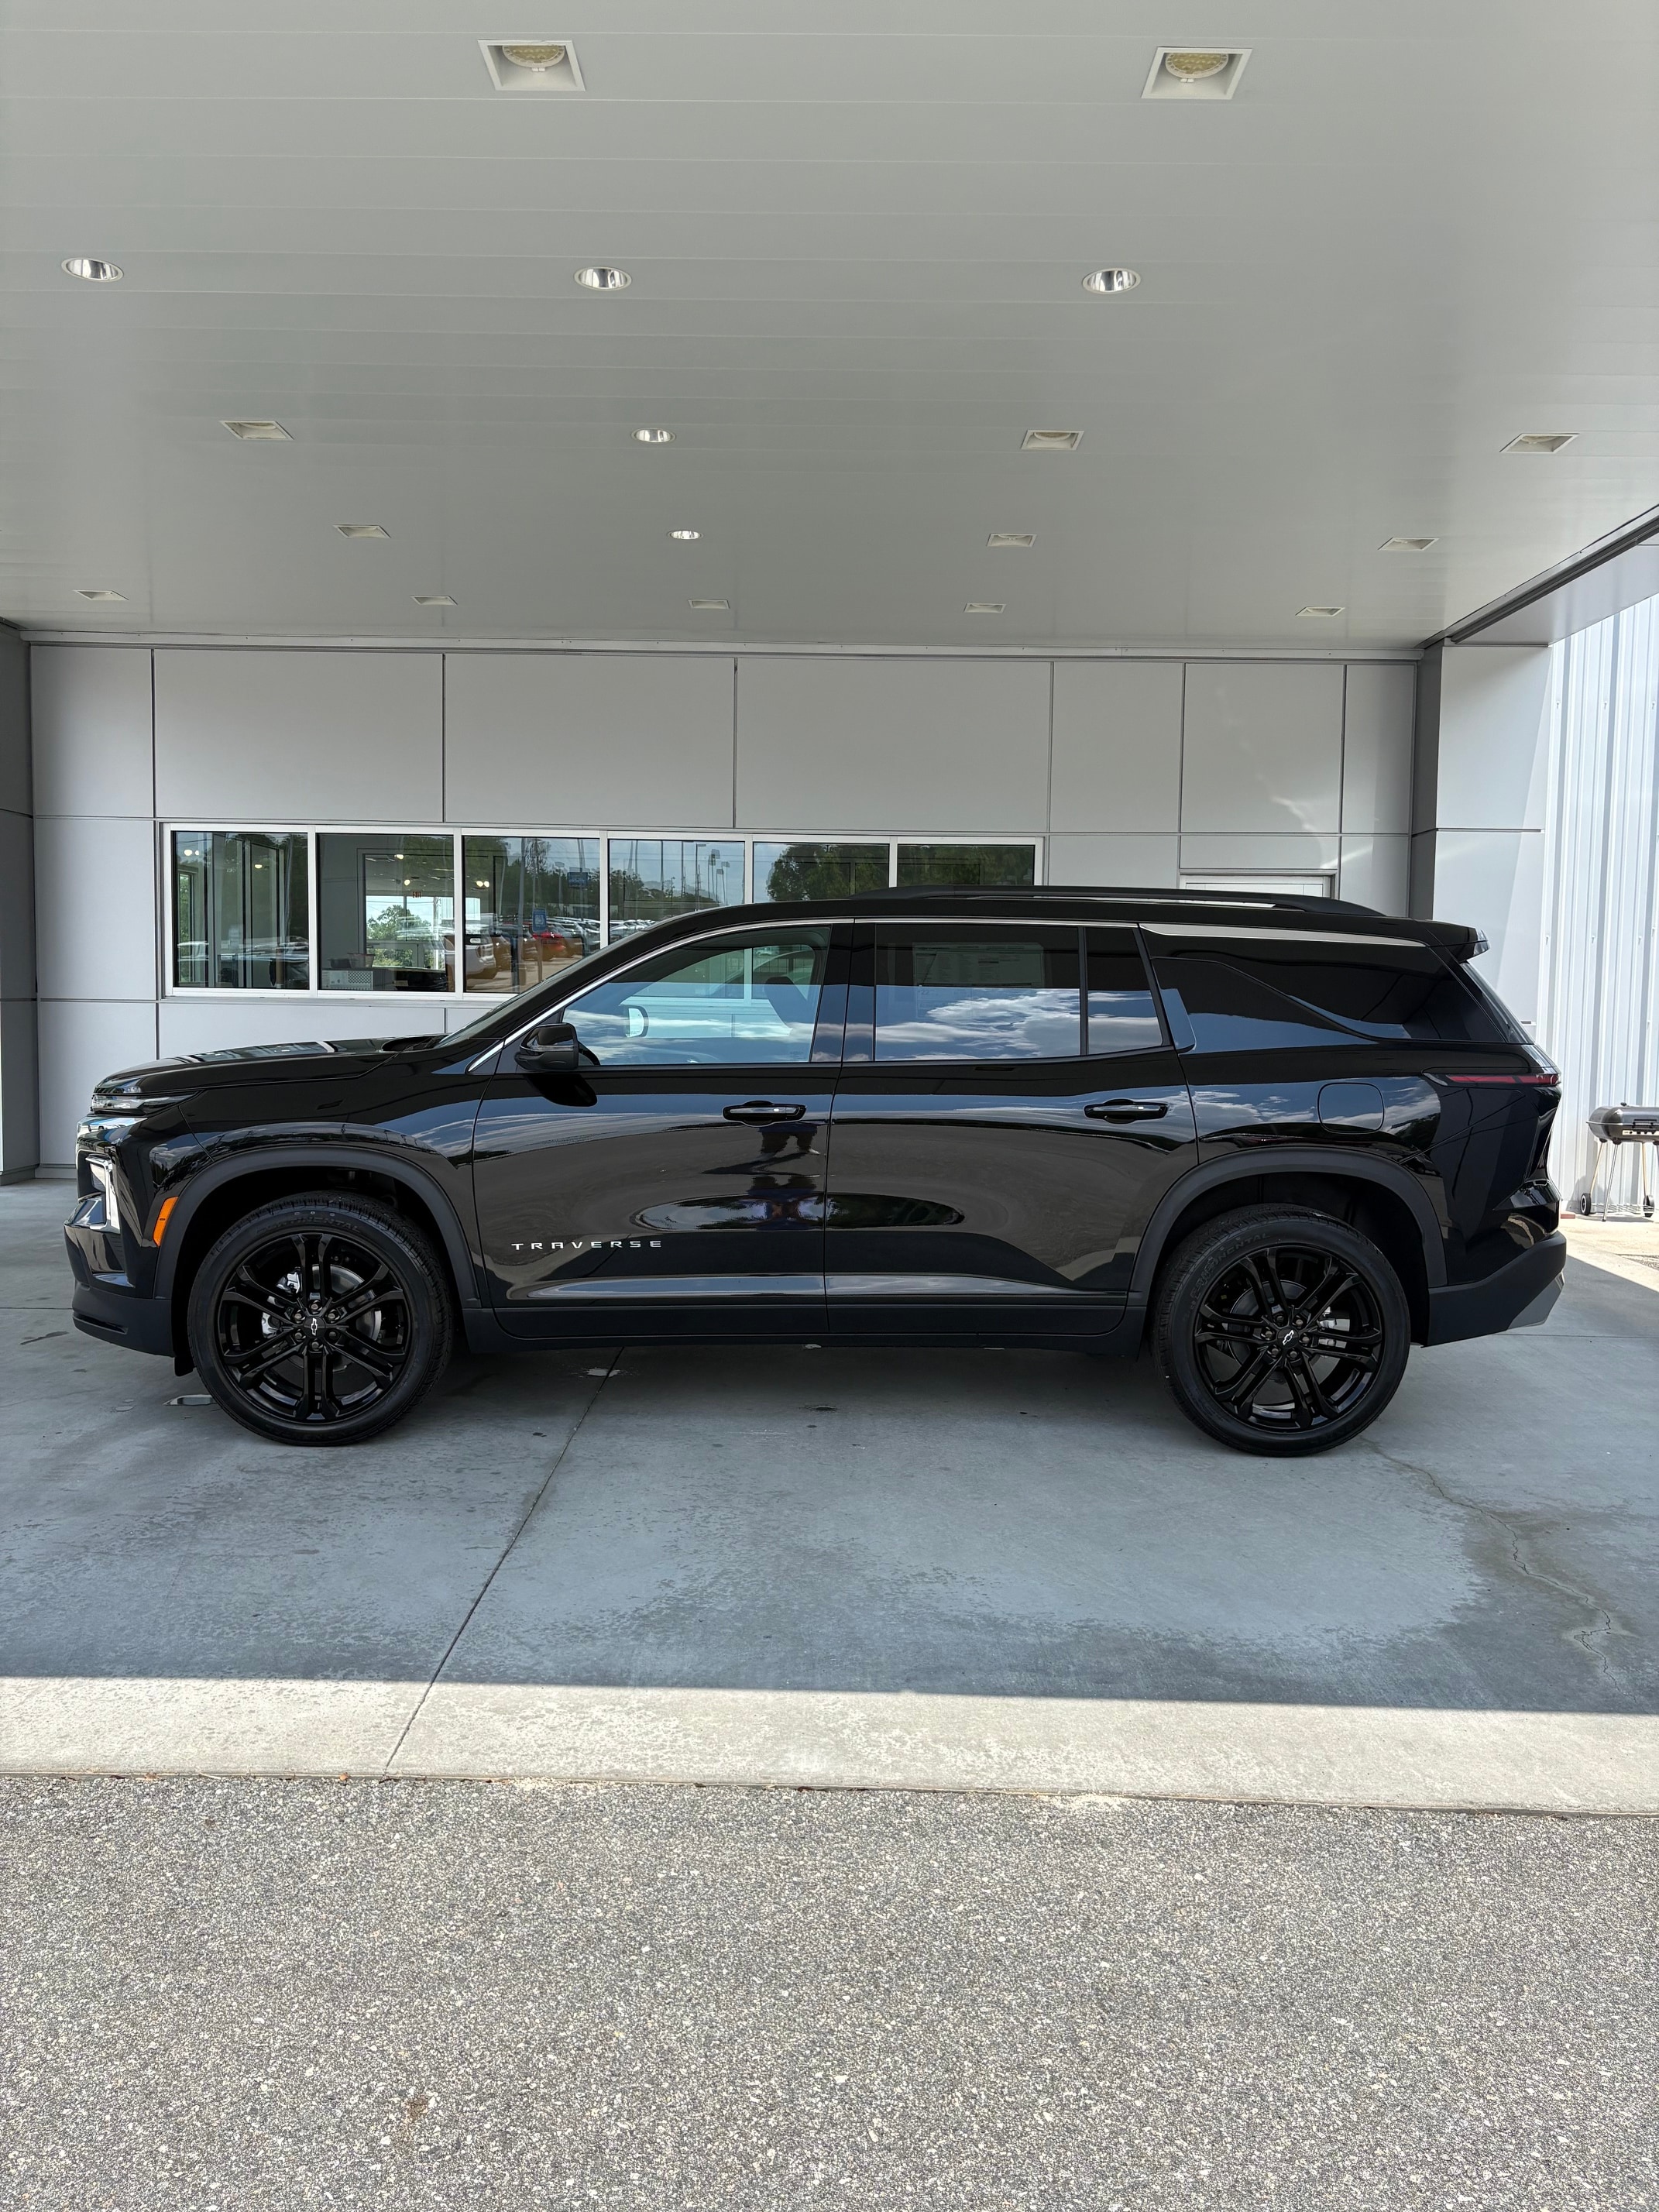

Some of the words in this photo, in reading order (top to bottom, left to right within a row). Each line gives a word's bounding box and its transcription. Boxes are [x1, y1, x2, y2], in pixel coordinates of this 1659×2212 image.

[256, 1217, 361, 1233] NTINENTAL
[511, 1241, 661, 1250] TRAVERSE
[1190, 1232, 1269, 1300] CNENTAL
